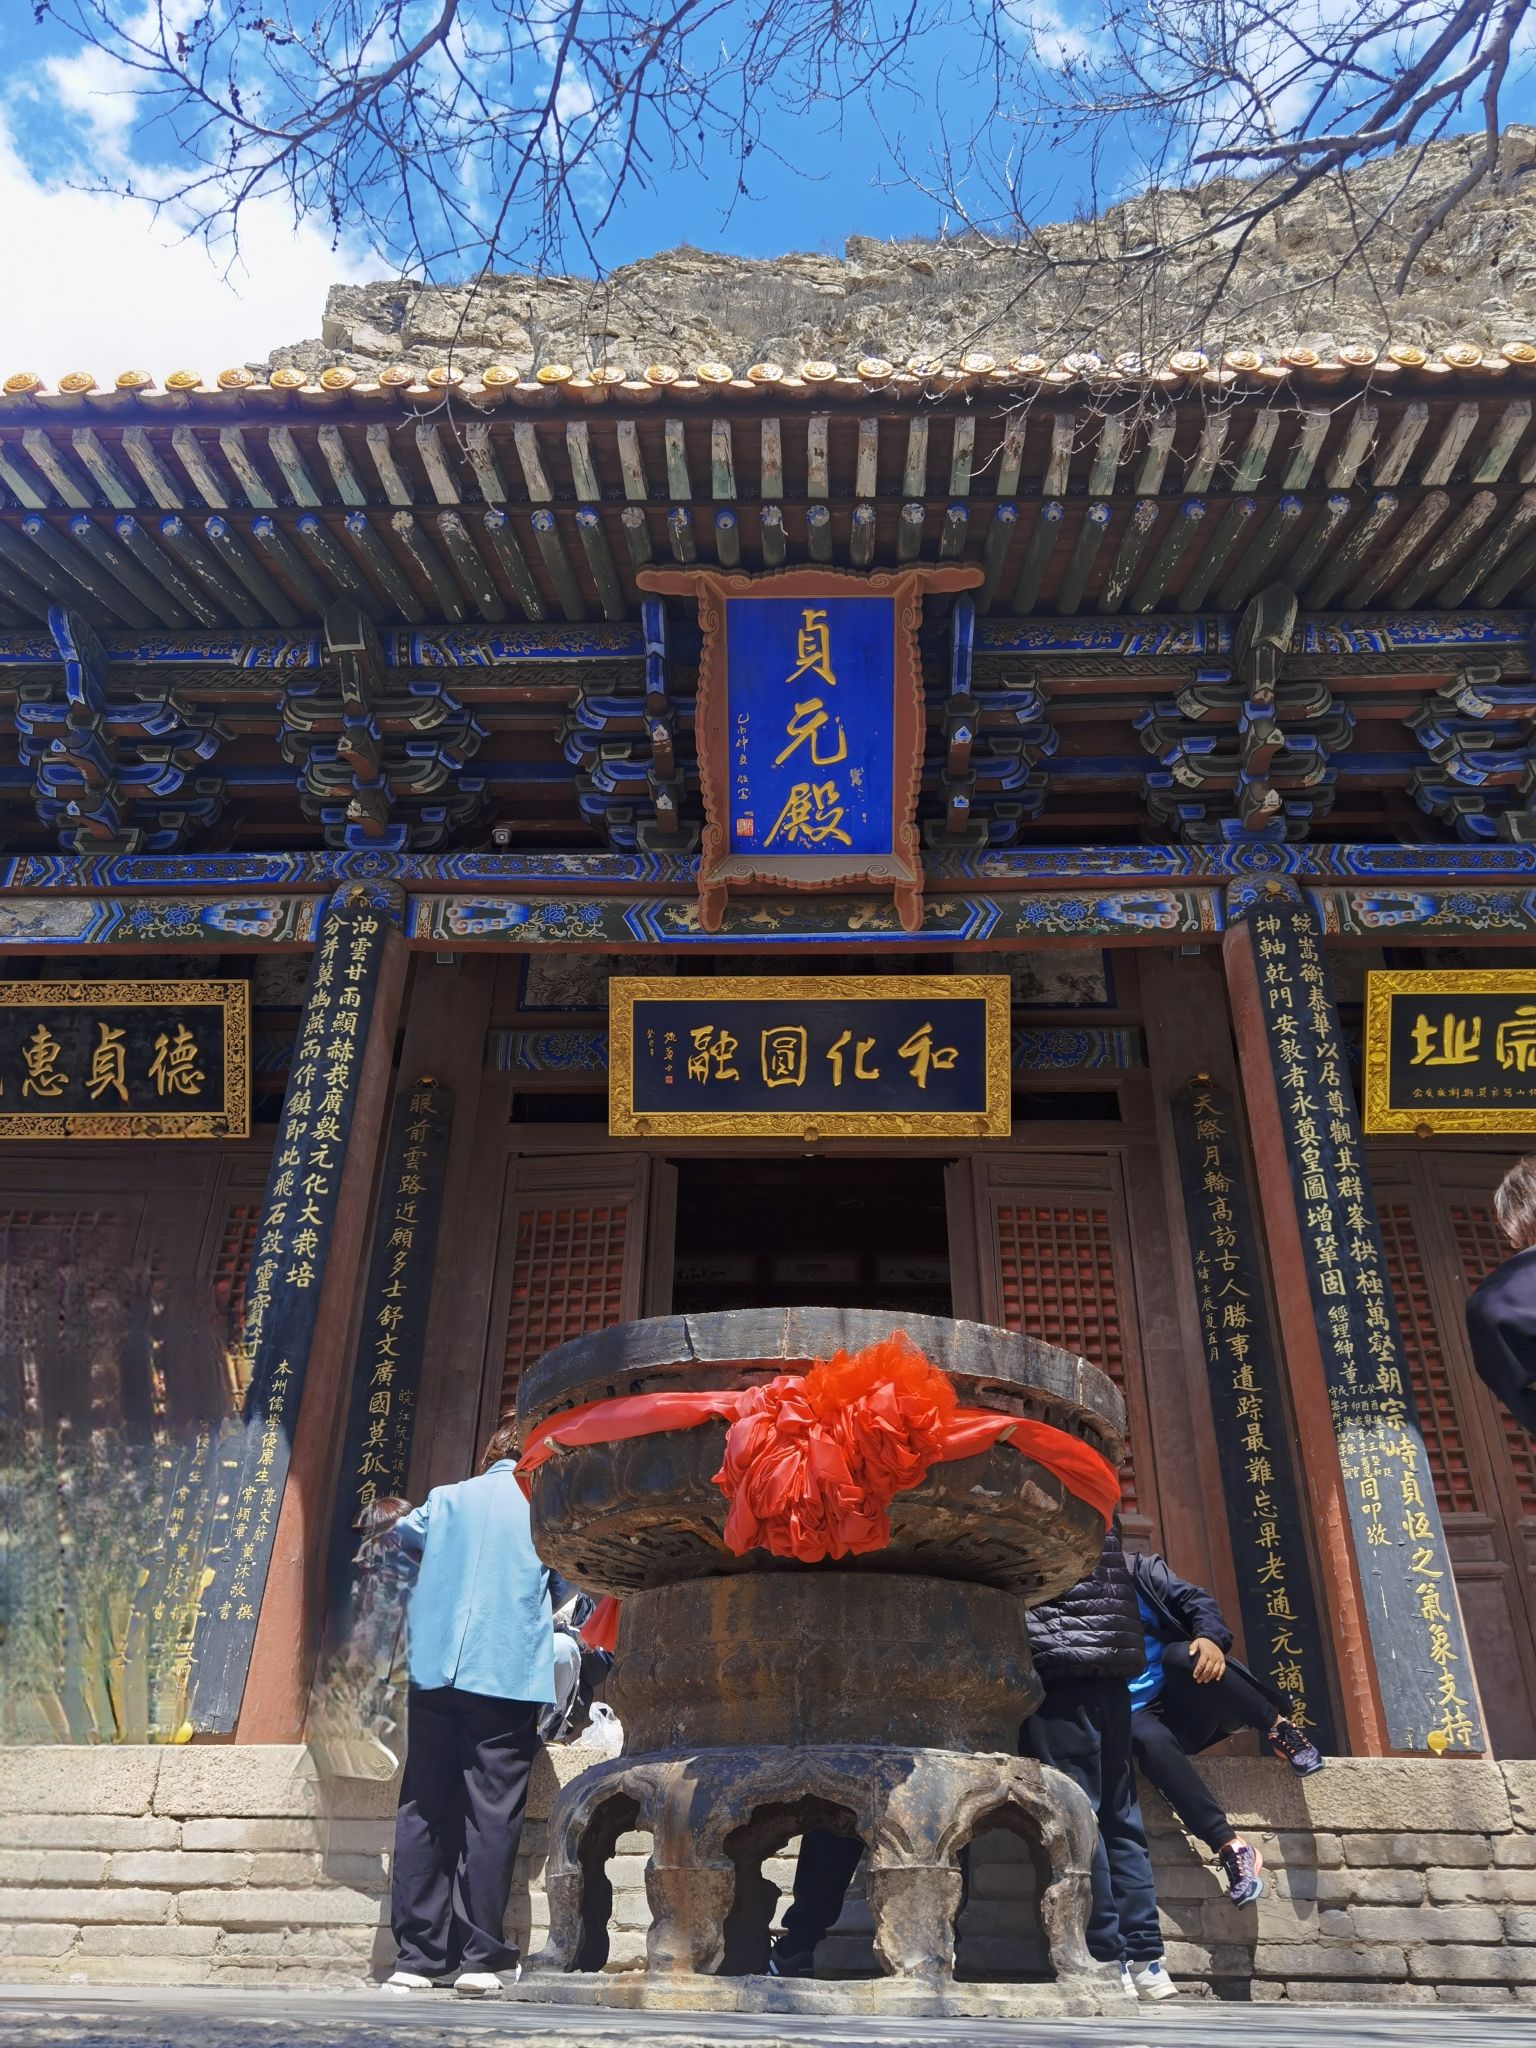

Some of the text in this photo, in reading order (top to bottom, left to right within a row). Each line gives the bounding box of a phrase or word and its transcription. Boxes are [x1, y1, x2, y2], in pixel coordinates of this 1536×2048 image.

[763, 608, 853, 847] 貞元殿
[0, 1022, 206, 1107] 德貞惠
